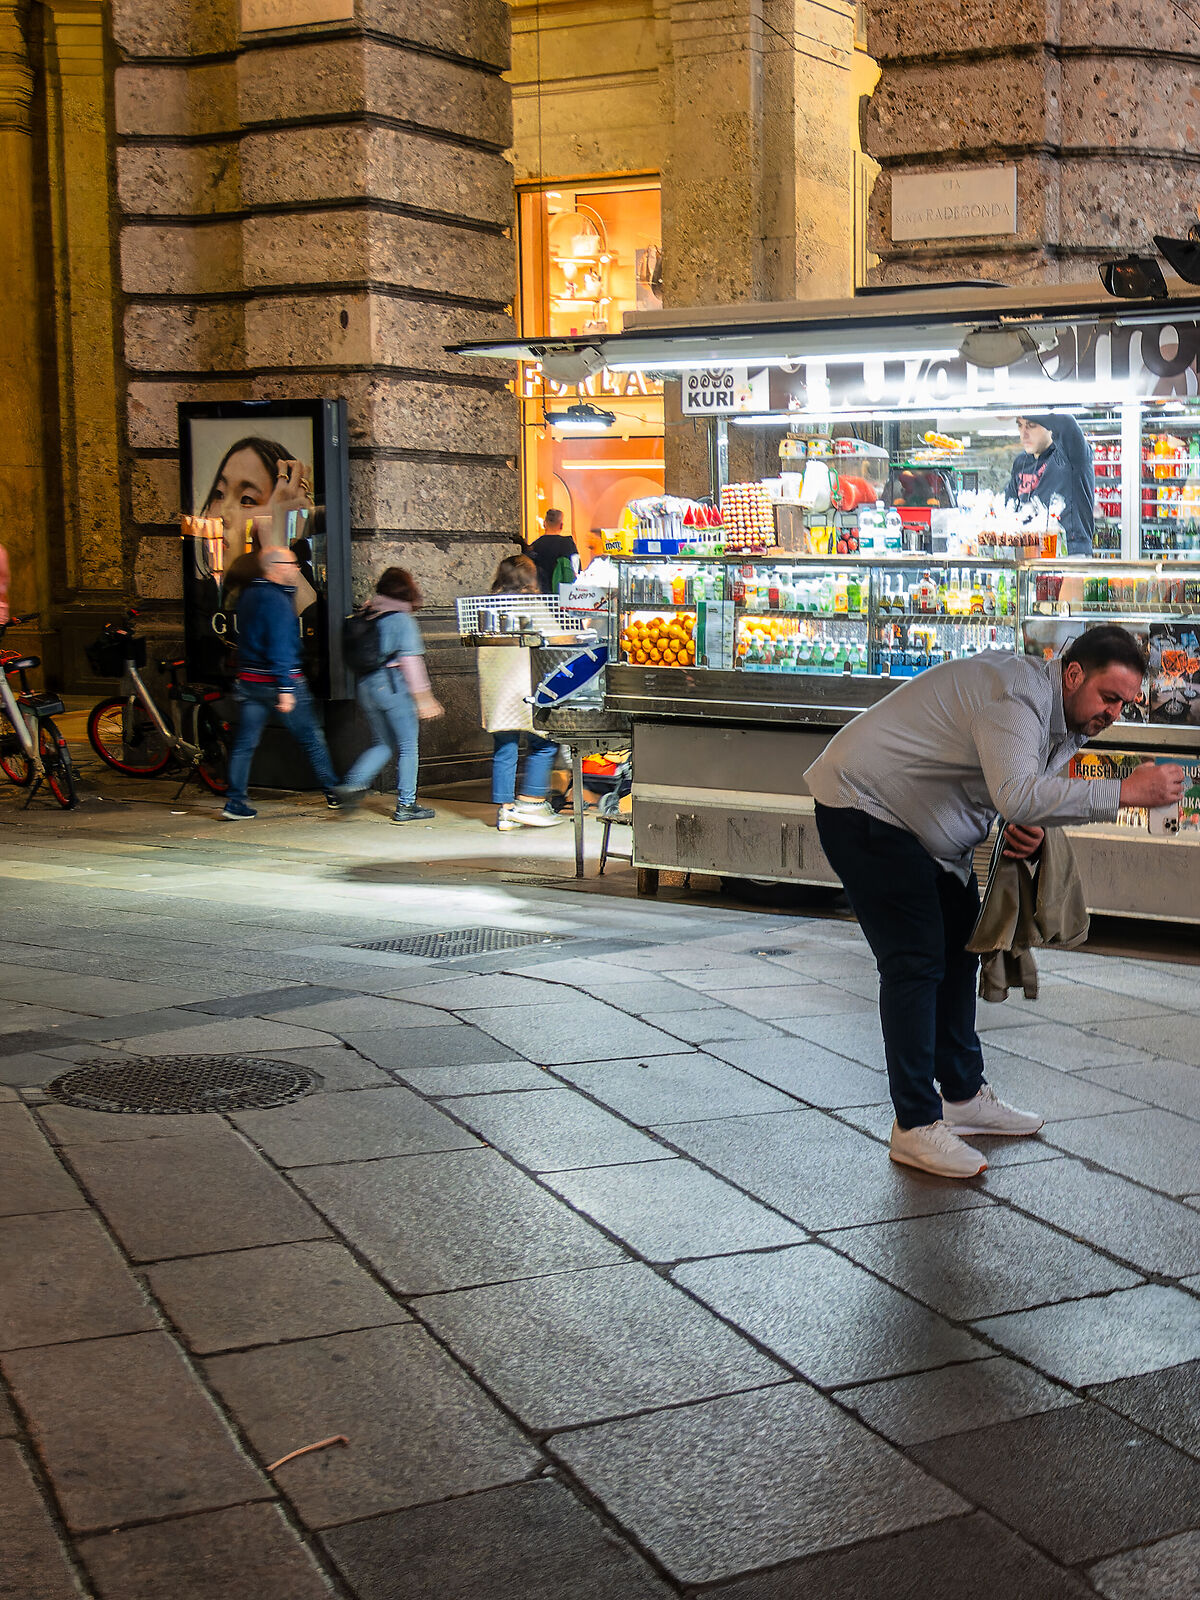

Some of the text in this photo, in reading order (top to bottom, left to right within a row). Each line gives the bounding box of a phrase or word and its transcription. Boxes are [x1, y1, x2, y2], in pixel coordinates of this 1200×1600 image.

[925, 202, 1011, 222] RADEGONDA
[525, 361, 649, 397] FLA
[688, 391, 735, 408] KURI
[568, 591, 596, 601] bueno
[1076, 763, 1112, 778] FRESH
